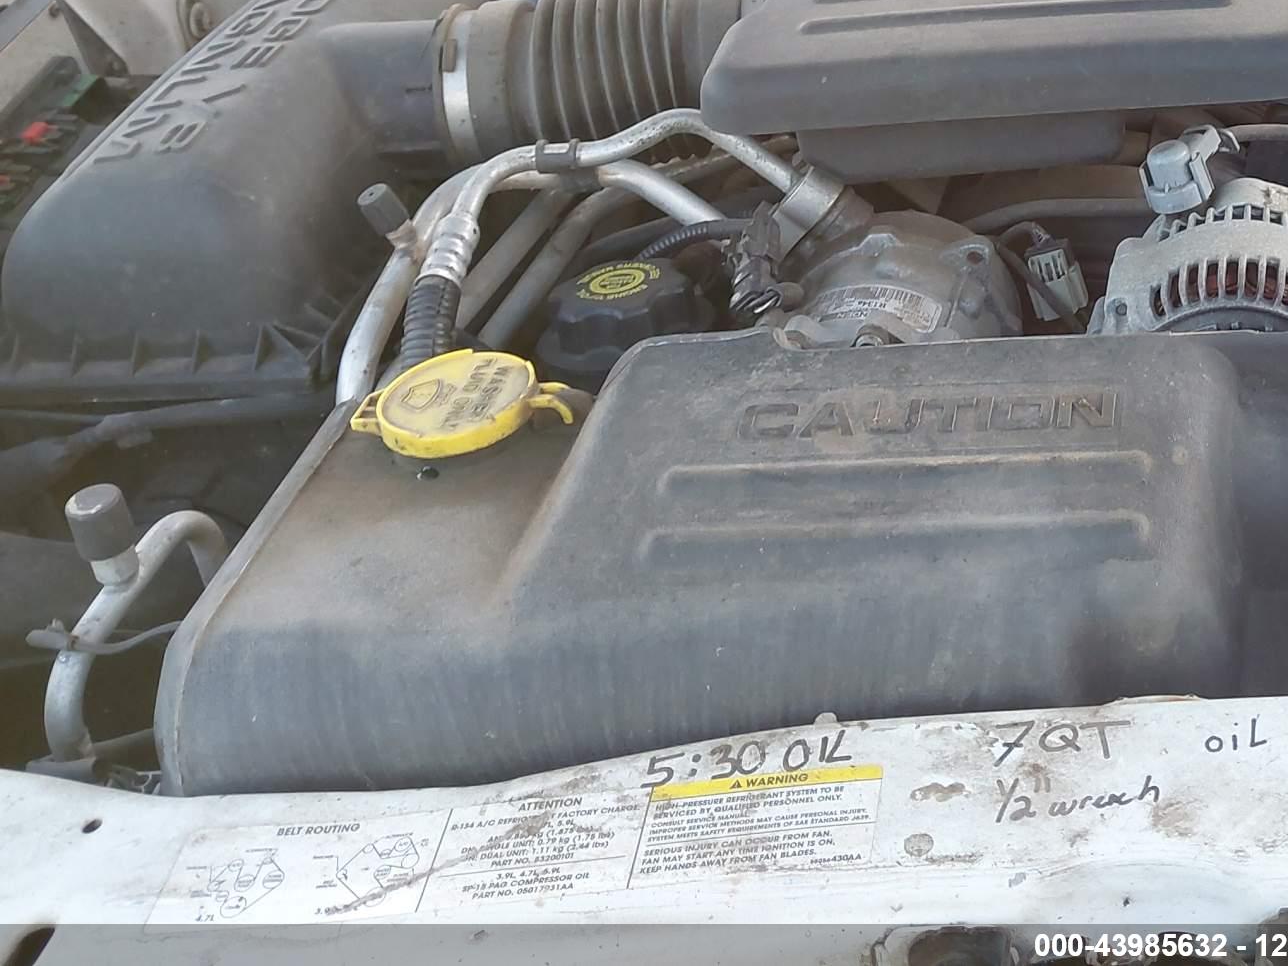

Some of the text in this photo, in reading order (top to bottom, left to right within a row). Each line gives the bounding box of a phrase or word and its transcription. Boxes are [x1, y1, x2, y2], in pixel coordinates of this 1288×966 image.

[738, 392, 1119, 439] CAUTION
[640, 740, 768, 788] 5:30
[746, 773, 809, 787] WARNING
[518, 797, 583, 812] ATTENTION
[653, 809, 697, 820] SERVICED
[714, 803, 760, 813] QUALIFIED
[763, 797, 814, 807] PERSONNEL
[817, 794, 842, 802] ONLY.
[655, 797, 724, 811] HIGH-PRESSURE
[726, 791, 784, 803] REFRIGERANT
[785, 788, 817, 797] SYSTEM
[476, 819, 495, 828] A/C
[557, 808, 598, 818] FACTORY
[649, 827, 685, 835] IMPROPER
[688, 823, 718, 831] SERVICE
[720, 819, 754, 827] METHODS
[800, 810, 838, 819] PERSONAL
[651, 820, 685, 828] CONSULT
[686, 816, 715, 824] SERVICE
[277, 823, 360, 836] BELT ROUTING
[727, 822, 781, 833] REQUIREMENTS
[560, 836, 569, 845] kg
[644, 830, 832, 856] SERIOUS INJURY CAN OCCUR FROM FAN.
[480, 851, 506, 860] DUAL
[553, 845, 564, 853] kg
[641, 858, 660, 866] FAN
[686, 851, 712, 860] START
[715, 849, 736, 857] ANY
[738, 846, 759, 854] TIME
[761, 841, 804, 852] IGNITION
[490, 859, 512, 867] PART
[514, 857, 530, 865] NO.
[639, 848, 817, 875] KEEP HANDS AWAY FROM FAN BLADES.
[510, 874, 573, 887] COMPRESSOR
[575, 872, 590, 880] OIL
[472, 890, 495, 899] PART
[499, 888, 514, 897] NO.
